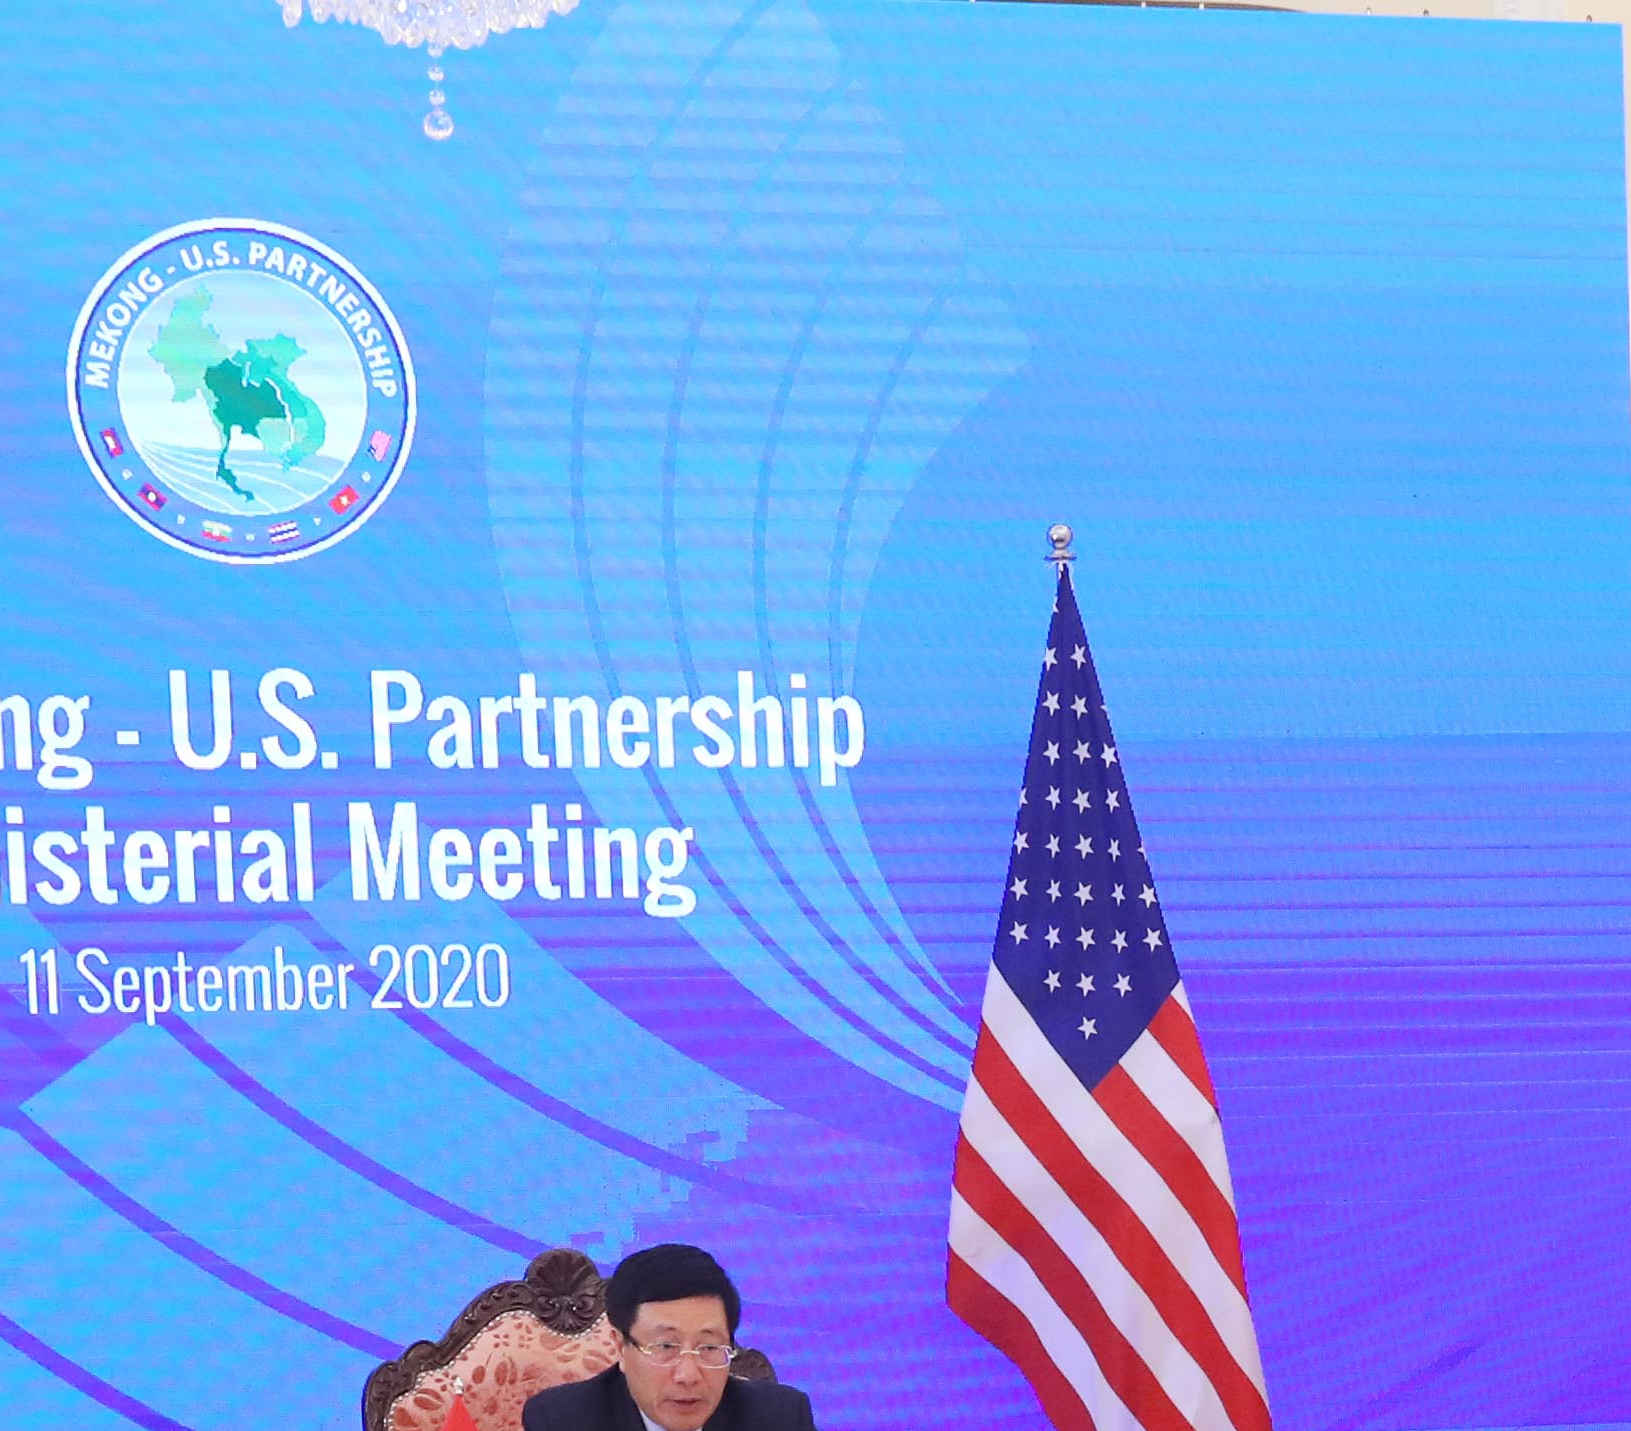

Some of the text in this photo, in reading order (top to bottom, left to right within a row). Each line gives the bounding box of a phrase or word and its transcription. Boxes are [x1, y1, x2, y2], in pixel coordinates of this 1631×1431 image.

[85, 267, 164, 389] MEKONG
[180, 240, 240, 271] U.S.
[248, 241, 398, 399] PARTNERSHIP
[116, 730, 140, 745] -
[169, 667, 339, 771] U.S.
[371, 669, 865, 787] Partnership
[347, 802, 697, 918] Meeting
[20, 943, 510, 1027] 11 September 2020
